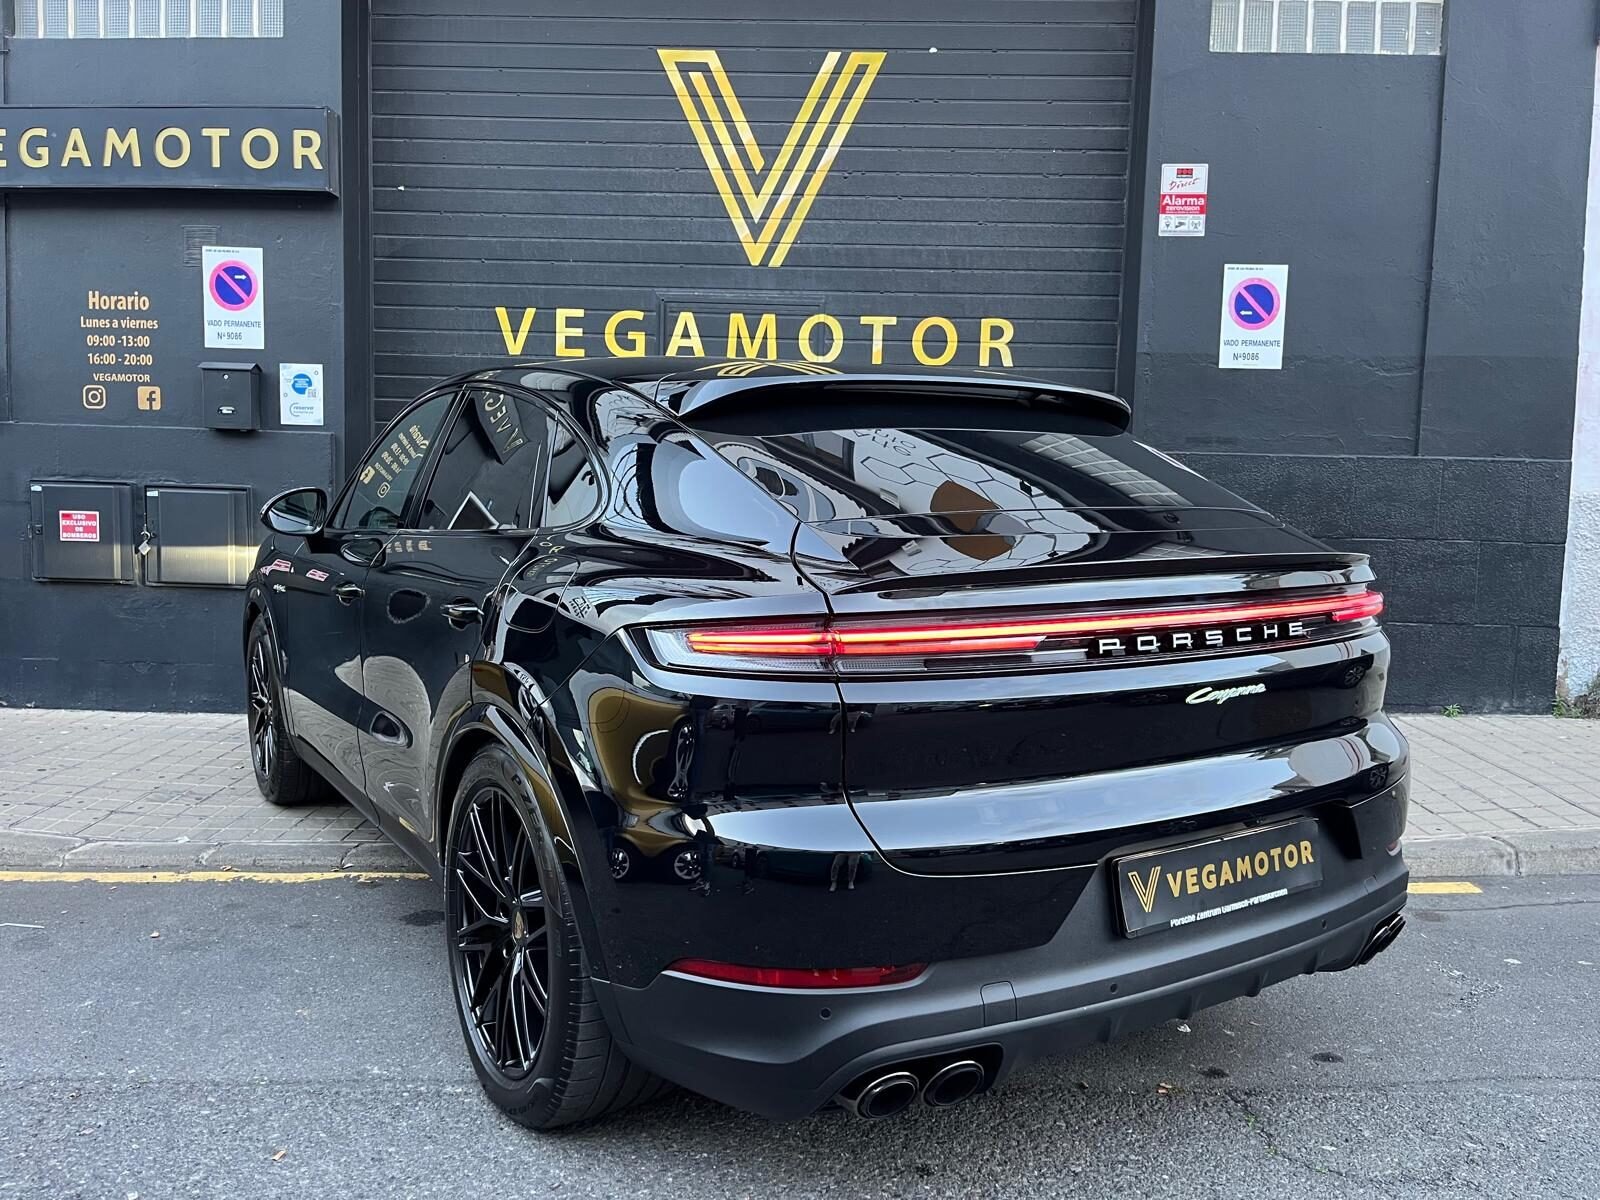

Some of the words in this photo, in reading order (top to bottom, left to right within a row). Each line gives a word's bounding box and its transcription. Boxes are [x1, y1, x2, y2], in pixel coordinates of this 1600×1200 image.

[1162, 194, 1205, 206] Alarma
[88, 290, 150, 311] Horario
[80, 316, 111, 329] Lunes
[112, 319, 119, 329] a
[120, 316, 159, 330] viernes
[207, 319, 222, 327] VADO
[223, 320, 262, 329] PERMANENTE
[86, 335, 116, 347] 09:00
[495, 306, 1017, 368] VEGAMOTOR
[1223, 339, 1239, 347] VADO
[1241, 339, 1281, 348] PERMANENTE
[87, 353, 116, 365] 16:00
[124, 354, 153, 366] 20:00
[93, 373, 151, 383] VEGAMOTOR
[1098, 620, 1304, 655] PORSCHE
[1185, 681, 1266, 705] Cayenne
[1166, 840, 1315, 898] VEGAMOTOR
[1170, 914, 1196, 928] Porsche
